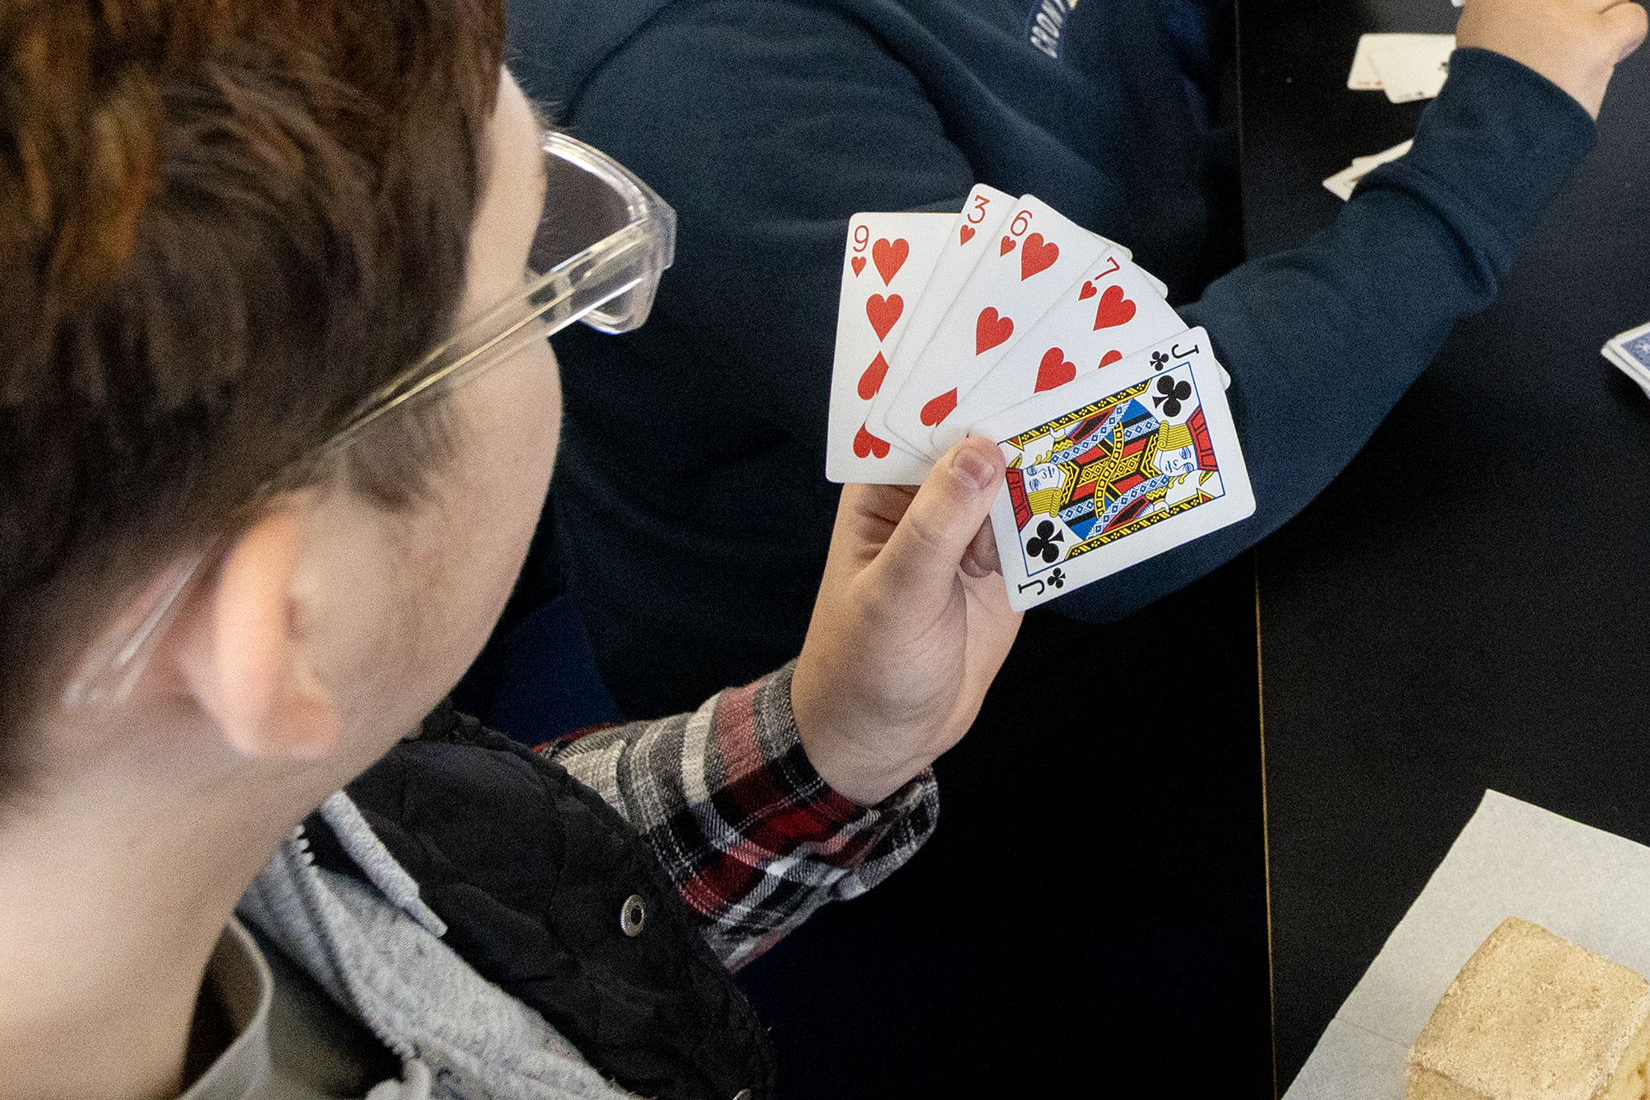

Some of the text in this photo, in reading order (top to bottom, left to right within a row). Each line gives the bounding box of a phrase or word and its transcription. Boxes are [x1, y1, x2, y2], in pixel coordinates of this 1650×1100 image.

[967, 195, 990, 224] 3
[1010, 210, 1033, 237] 6
[853, 225, 870, 253] 9
[1095, 256, 1120, 281] 7
[1171, 343, 1199, 359] J
[1018, 579, 1045, 596] J
